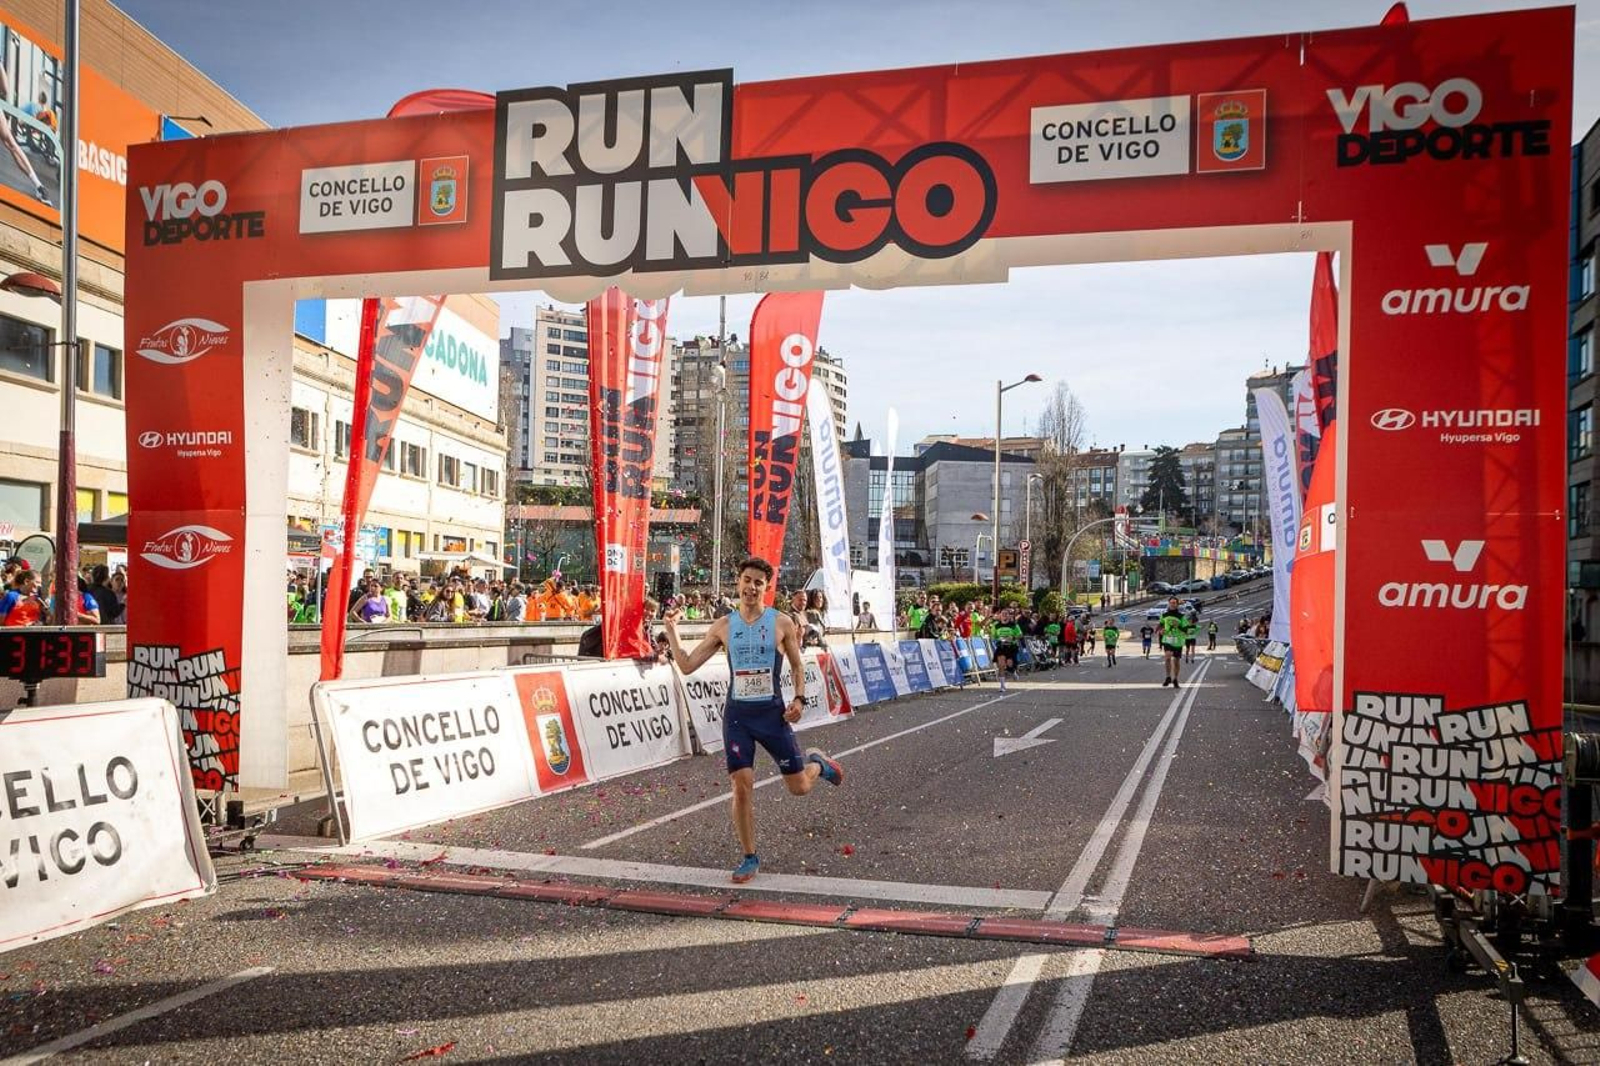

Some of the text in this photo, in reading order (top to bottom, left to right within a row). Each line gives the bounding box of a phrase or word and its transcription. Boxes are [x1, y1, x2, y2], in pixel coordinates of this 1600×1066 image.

[1325, 77, 1483, 135] VIGO
[505, 81, 723, 181] RUN
[1042, 114, 1176, 141] CONCELLO
[1336, 120, 1552, 169] DEPORTE
[1057, 139, 1160, 164] DE VIGO
[139, 180, 227, 221] VIGO
[309, 175, 405, 198] CONCELLO
[319, 197, 392, 217] DE VIGO
[143, 211, 265, 247] DEPORTE
[1381, 285, 1530, 315] amura
[1422, 409, 1540, 427] HYUNDAI
[167, 431, 231, 446] HYUNDAI
[1440, 432, 1520, 444] Hyupersa Vigo
[1378, 581, 1529, 611] amura
[134, 646, 226, 682] RUN RUN
[744, 677, 762, 687] 348
[589, 684, 670, 717] CONCELLO
[362, 705, 500, 753] CONCELLO
[606, 714, 673, 749] DE VIGO
[1356, 694, 1442, 726] RUN
[1437, 703, 1530, 745] RUN
[390, 747, 495, 795] DE VIGO
[1391, 745, 1479, 780] RUN
[0, 755, 139, 820] ELLO
[1345, 819, 1430, 854] RUN
